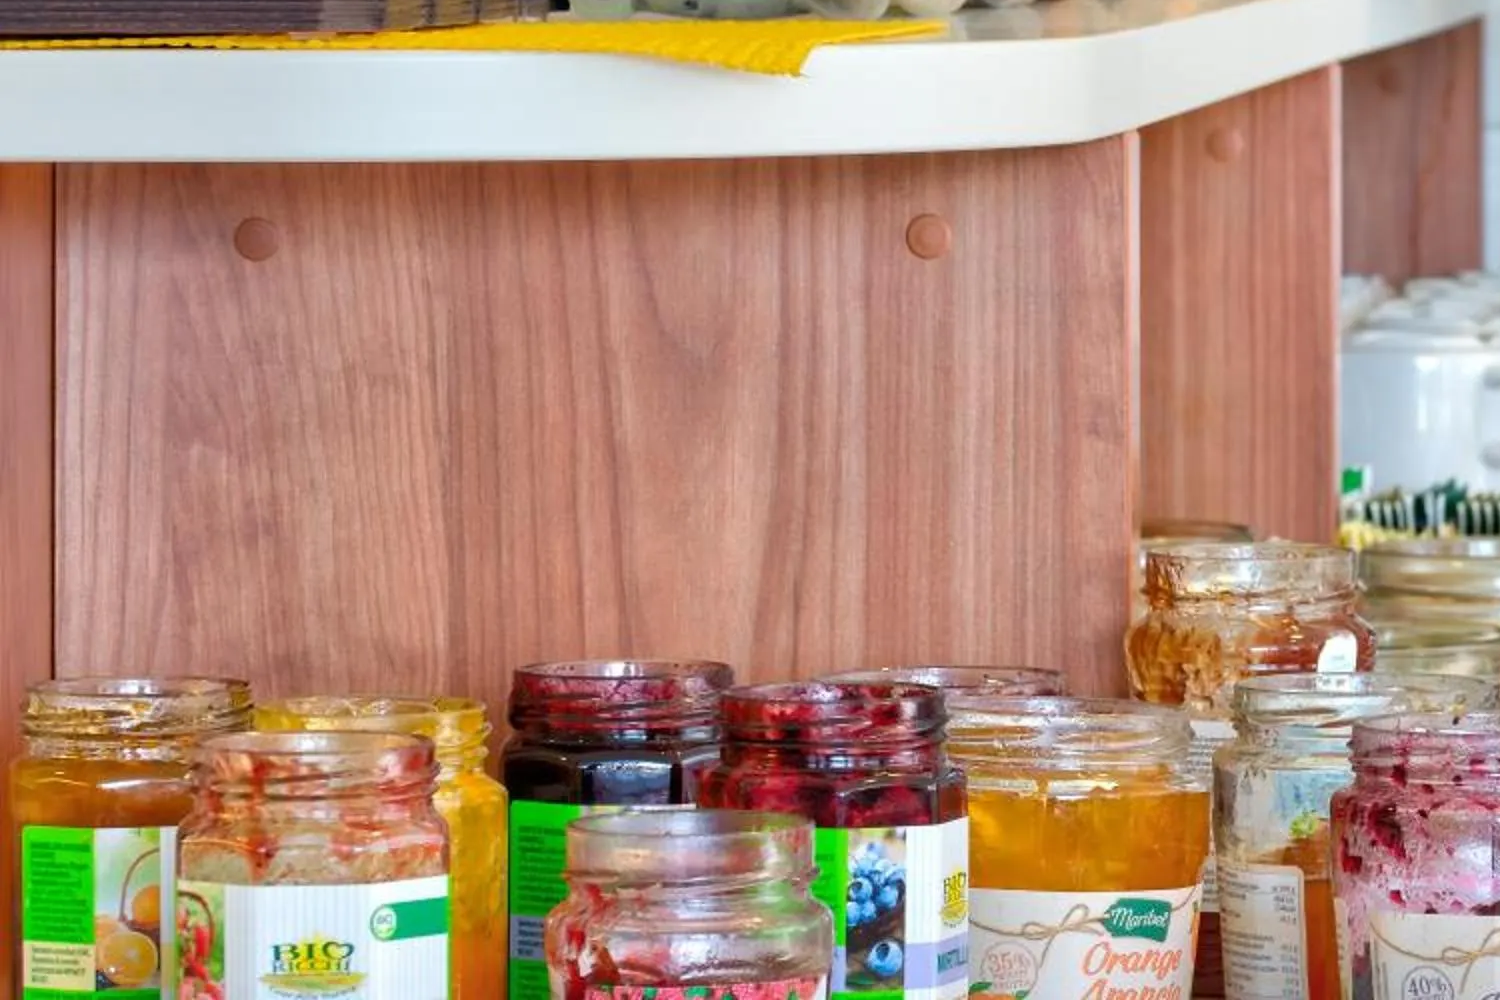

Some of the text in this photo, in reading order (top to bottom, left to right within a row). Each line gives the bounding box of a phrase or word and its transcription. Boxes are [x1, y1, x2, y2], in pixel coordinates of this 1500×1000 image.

[1111, 906, 1168, 931] Maribel
[1081, 941, 1184, 980] Orange
[1407, 976, 1447, 997] 40%
